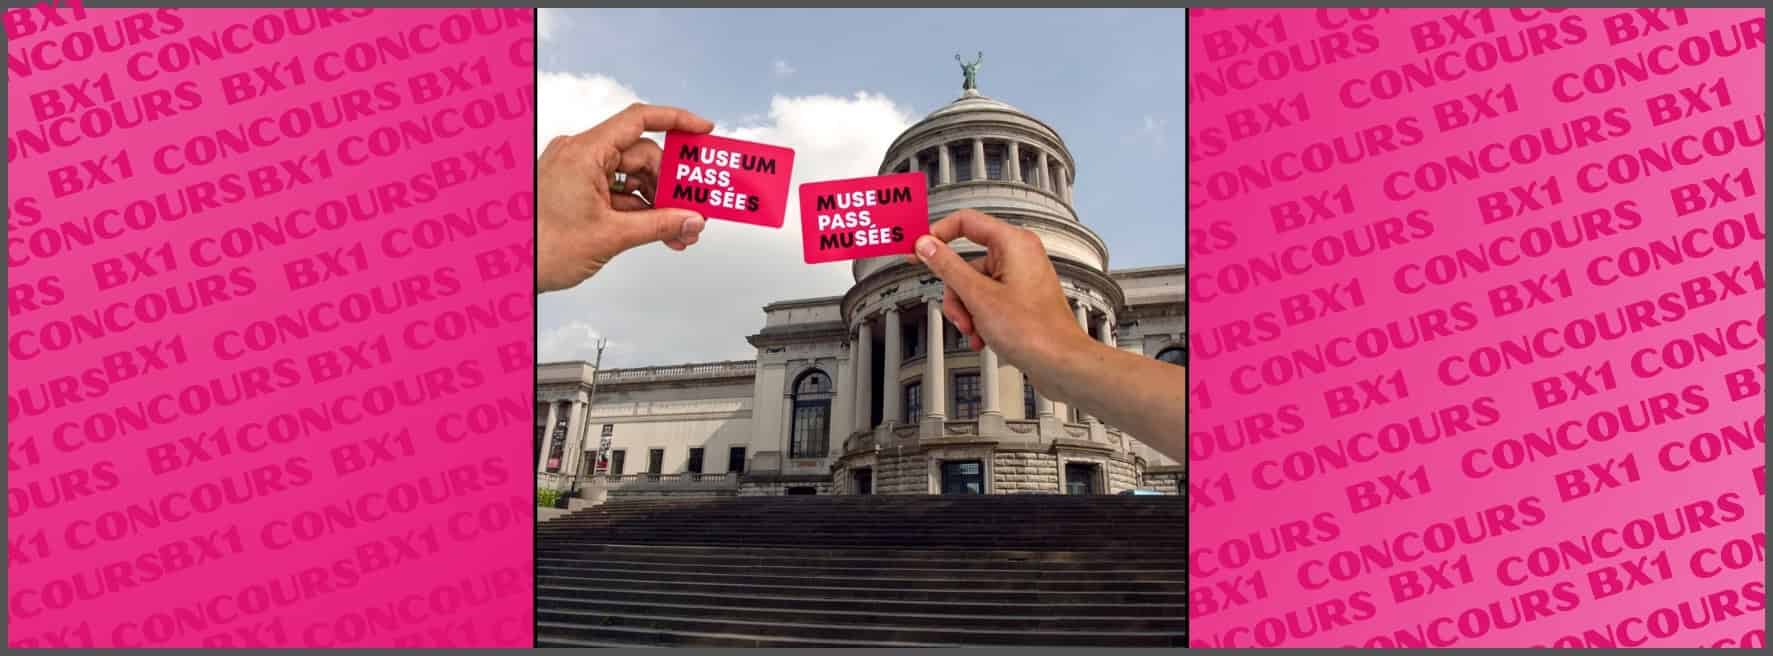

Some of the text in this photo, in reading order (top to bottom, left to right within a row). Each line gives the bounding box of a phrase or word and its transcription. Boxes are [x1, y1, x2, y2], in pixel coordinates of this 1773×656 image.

[679, 144, 776, 175] MUSEUM
[676, 164, 731, 187] PASS
[673, 185, 759, 212] MUSÉES
[816, 186, 912, 212] MUSEUM
[817, 210, 871, 231] PASS
[819, 225, 904, 251] MUSÉES
